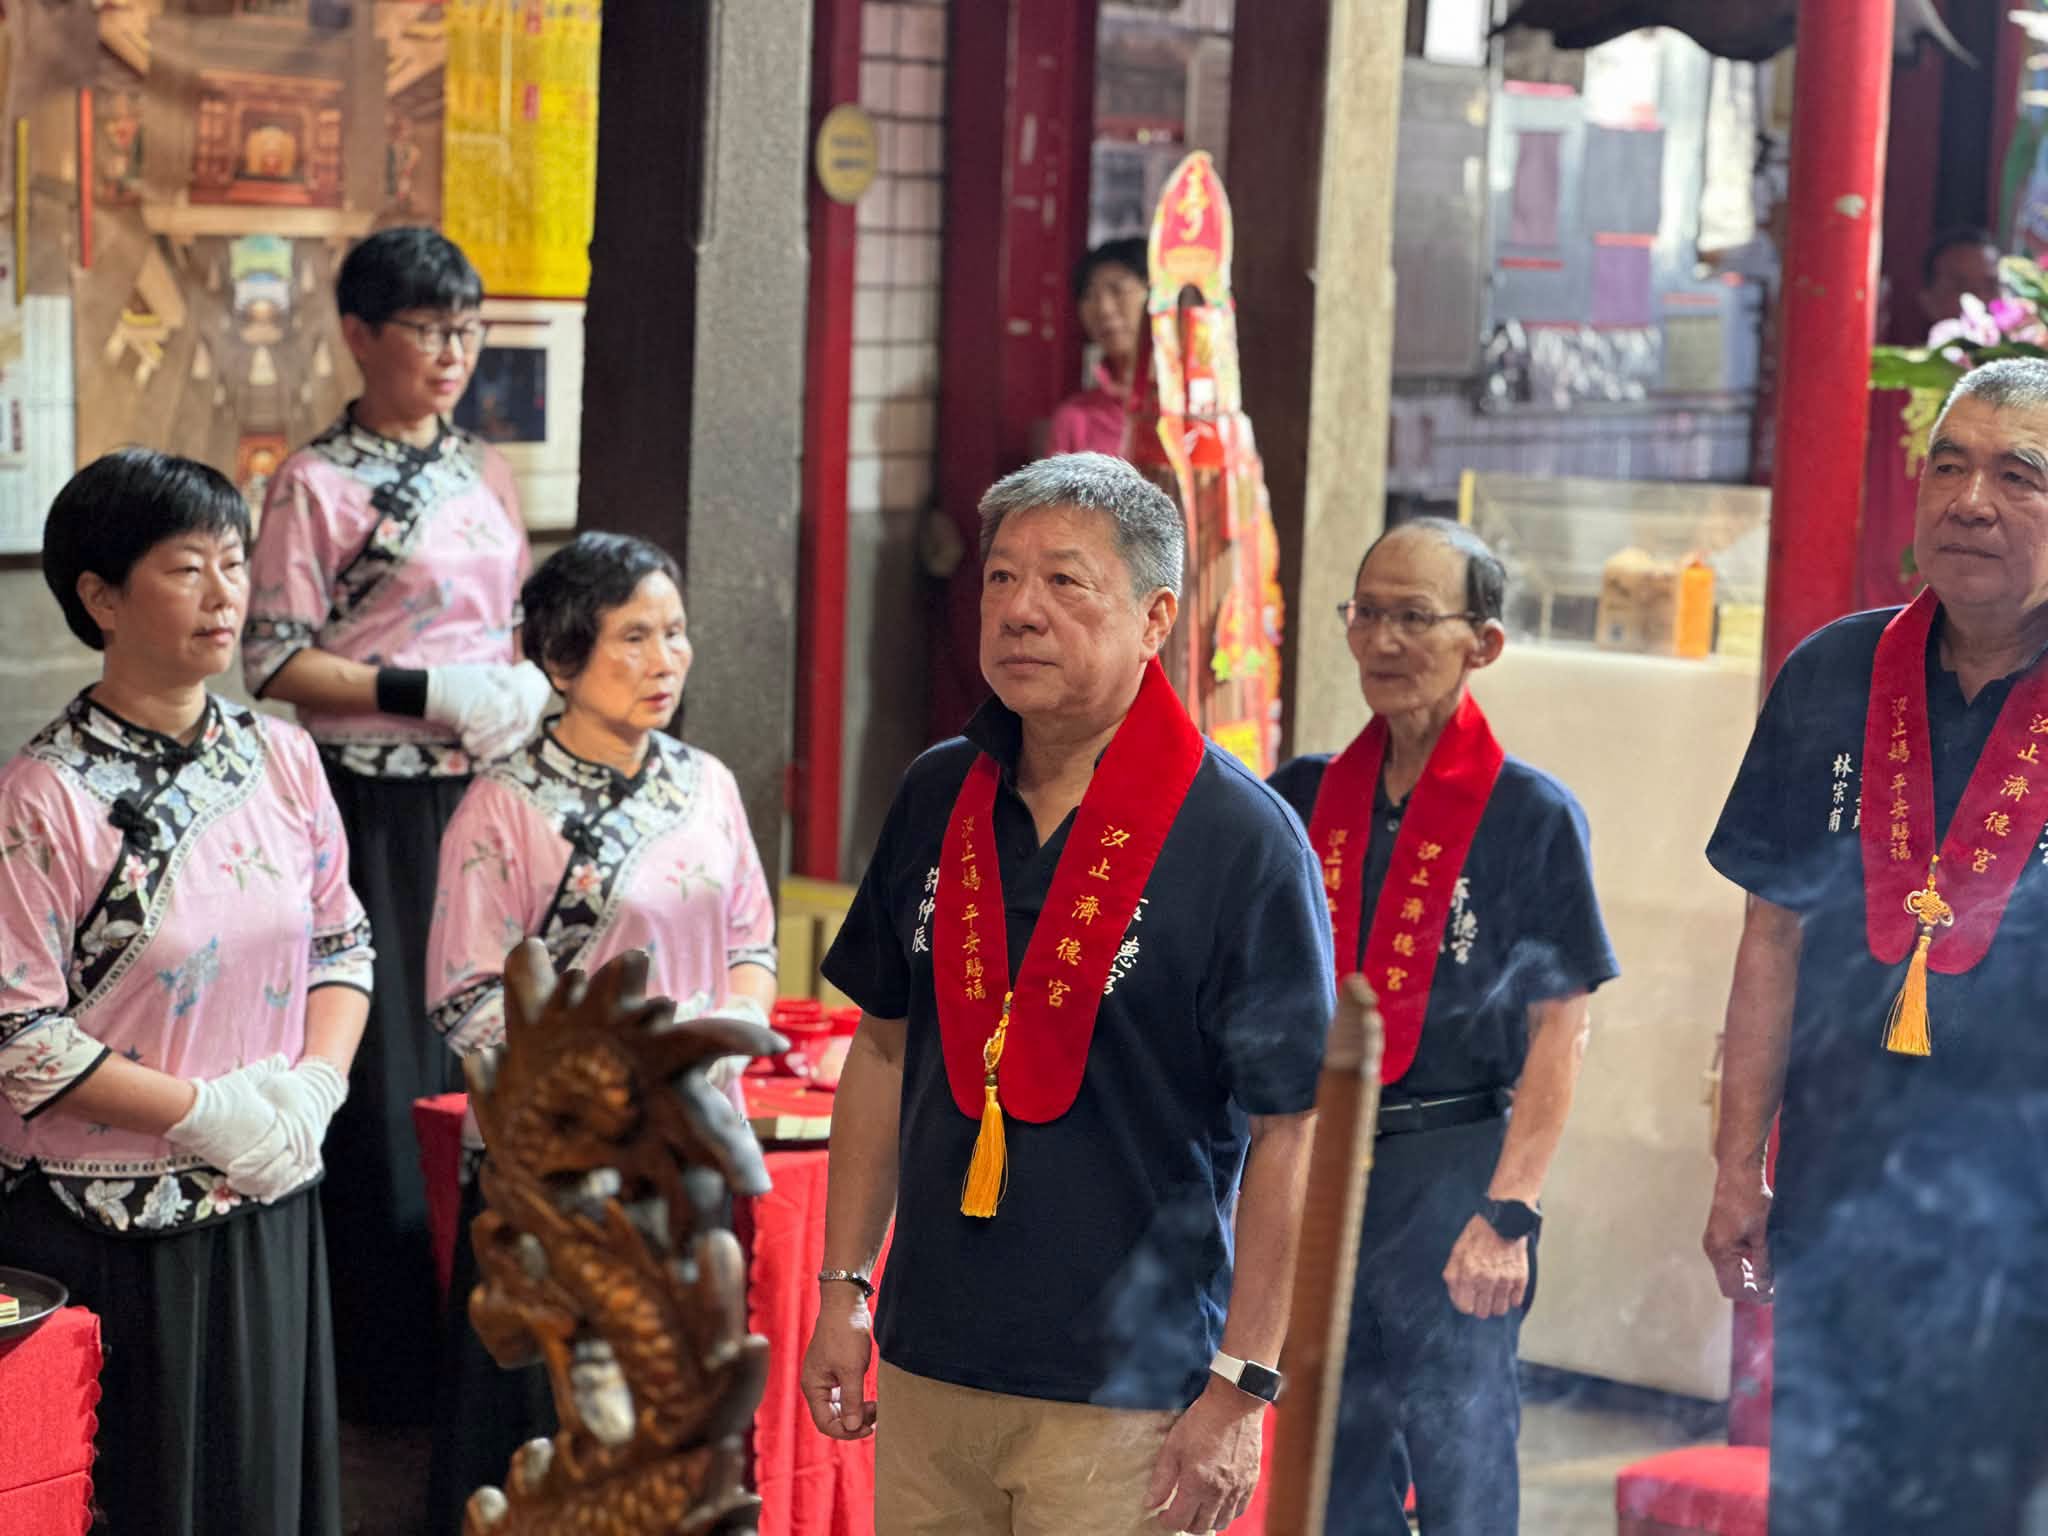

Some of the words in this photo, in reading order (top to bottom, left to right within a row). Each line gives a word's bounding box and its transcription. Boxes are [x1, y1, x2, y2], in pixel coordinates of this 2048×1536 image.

[1047, 824, 1131, 1009] 汐止濟德宮
